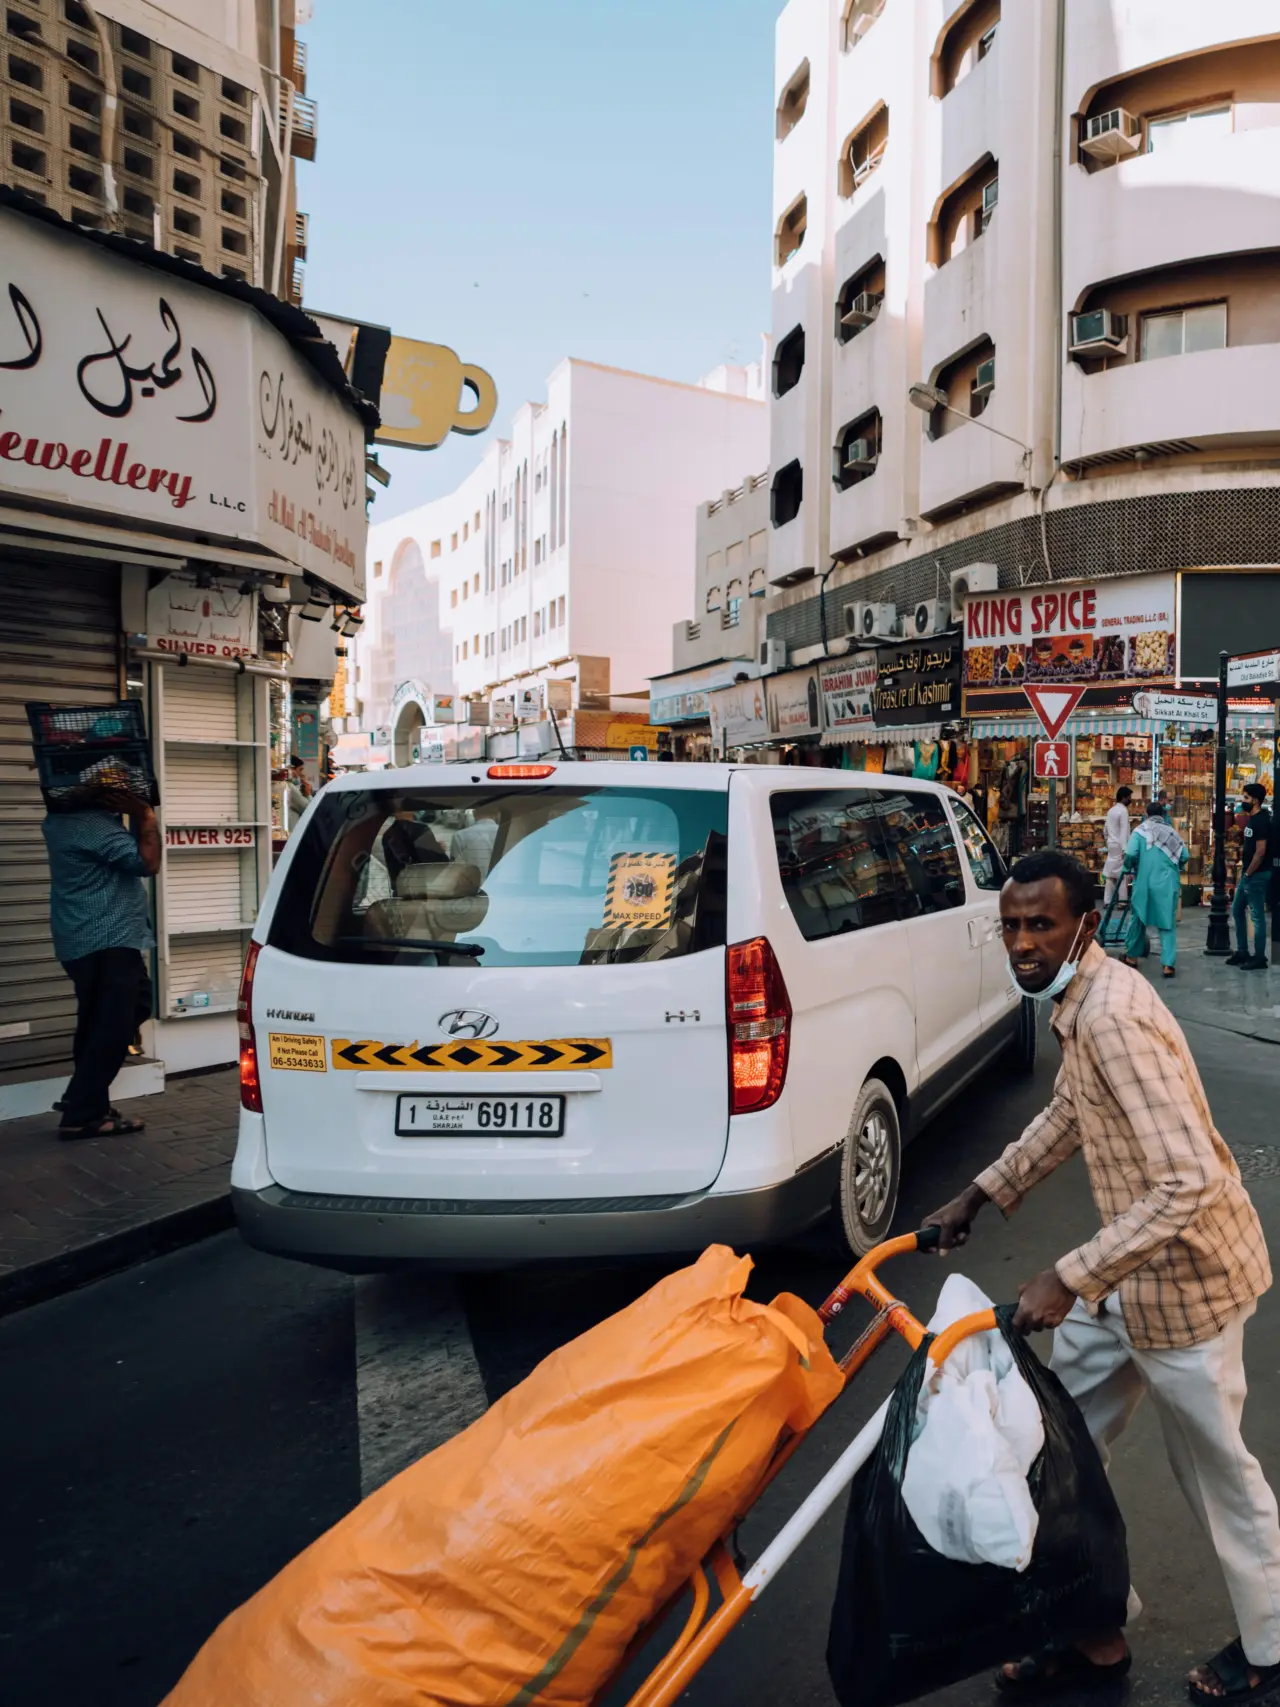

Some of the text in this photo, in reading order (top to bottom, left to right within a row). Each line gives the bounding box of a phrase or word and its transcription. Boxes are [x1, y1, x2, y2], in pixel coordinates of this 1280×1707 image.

[210, 492, 246, 513] L.L.C
[967, 597, 1022, 639] KING
[1030, 589, 1097, 633] SPICE
[1101, 617, 1122, 627] GENERAL
[1123, 614, 1145, 626] TRADING
[822, 673, 853, 692] IBRAHIM
[1240, 673, 1249, 681] Old
[873, 687, 907, 710] Treasure
[908, 684, 916, 707] of
[918, 678, 952, 705] Kashmir
[1197, 698, 1214, 708] شارع
[1154, 708, 1174, 716] Sikkat
[1184, 710, 1199, 718] Khail
[165, 828, 252, 846] SILVER 925
[613, 912, 661, 920] MAX SPEED
[283, 1036, 301, 1045] Driving
[302, 1037, 317, 1046] Safely
[291, 1047, 307, 1056] Please
[272, 1056, 324, 1068] 06-5343633
[426, 1100, 474, 1113] الشارقة
[410, 1104, 416, 1124] 1
[477, 1101, 553, 1128] 69118
